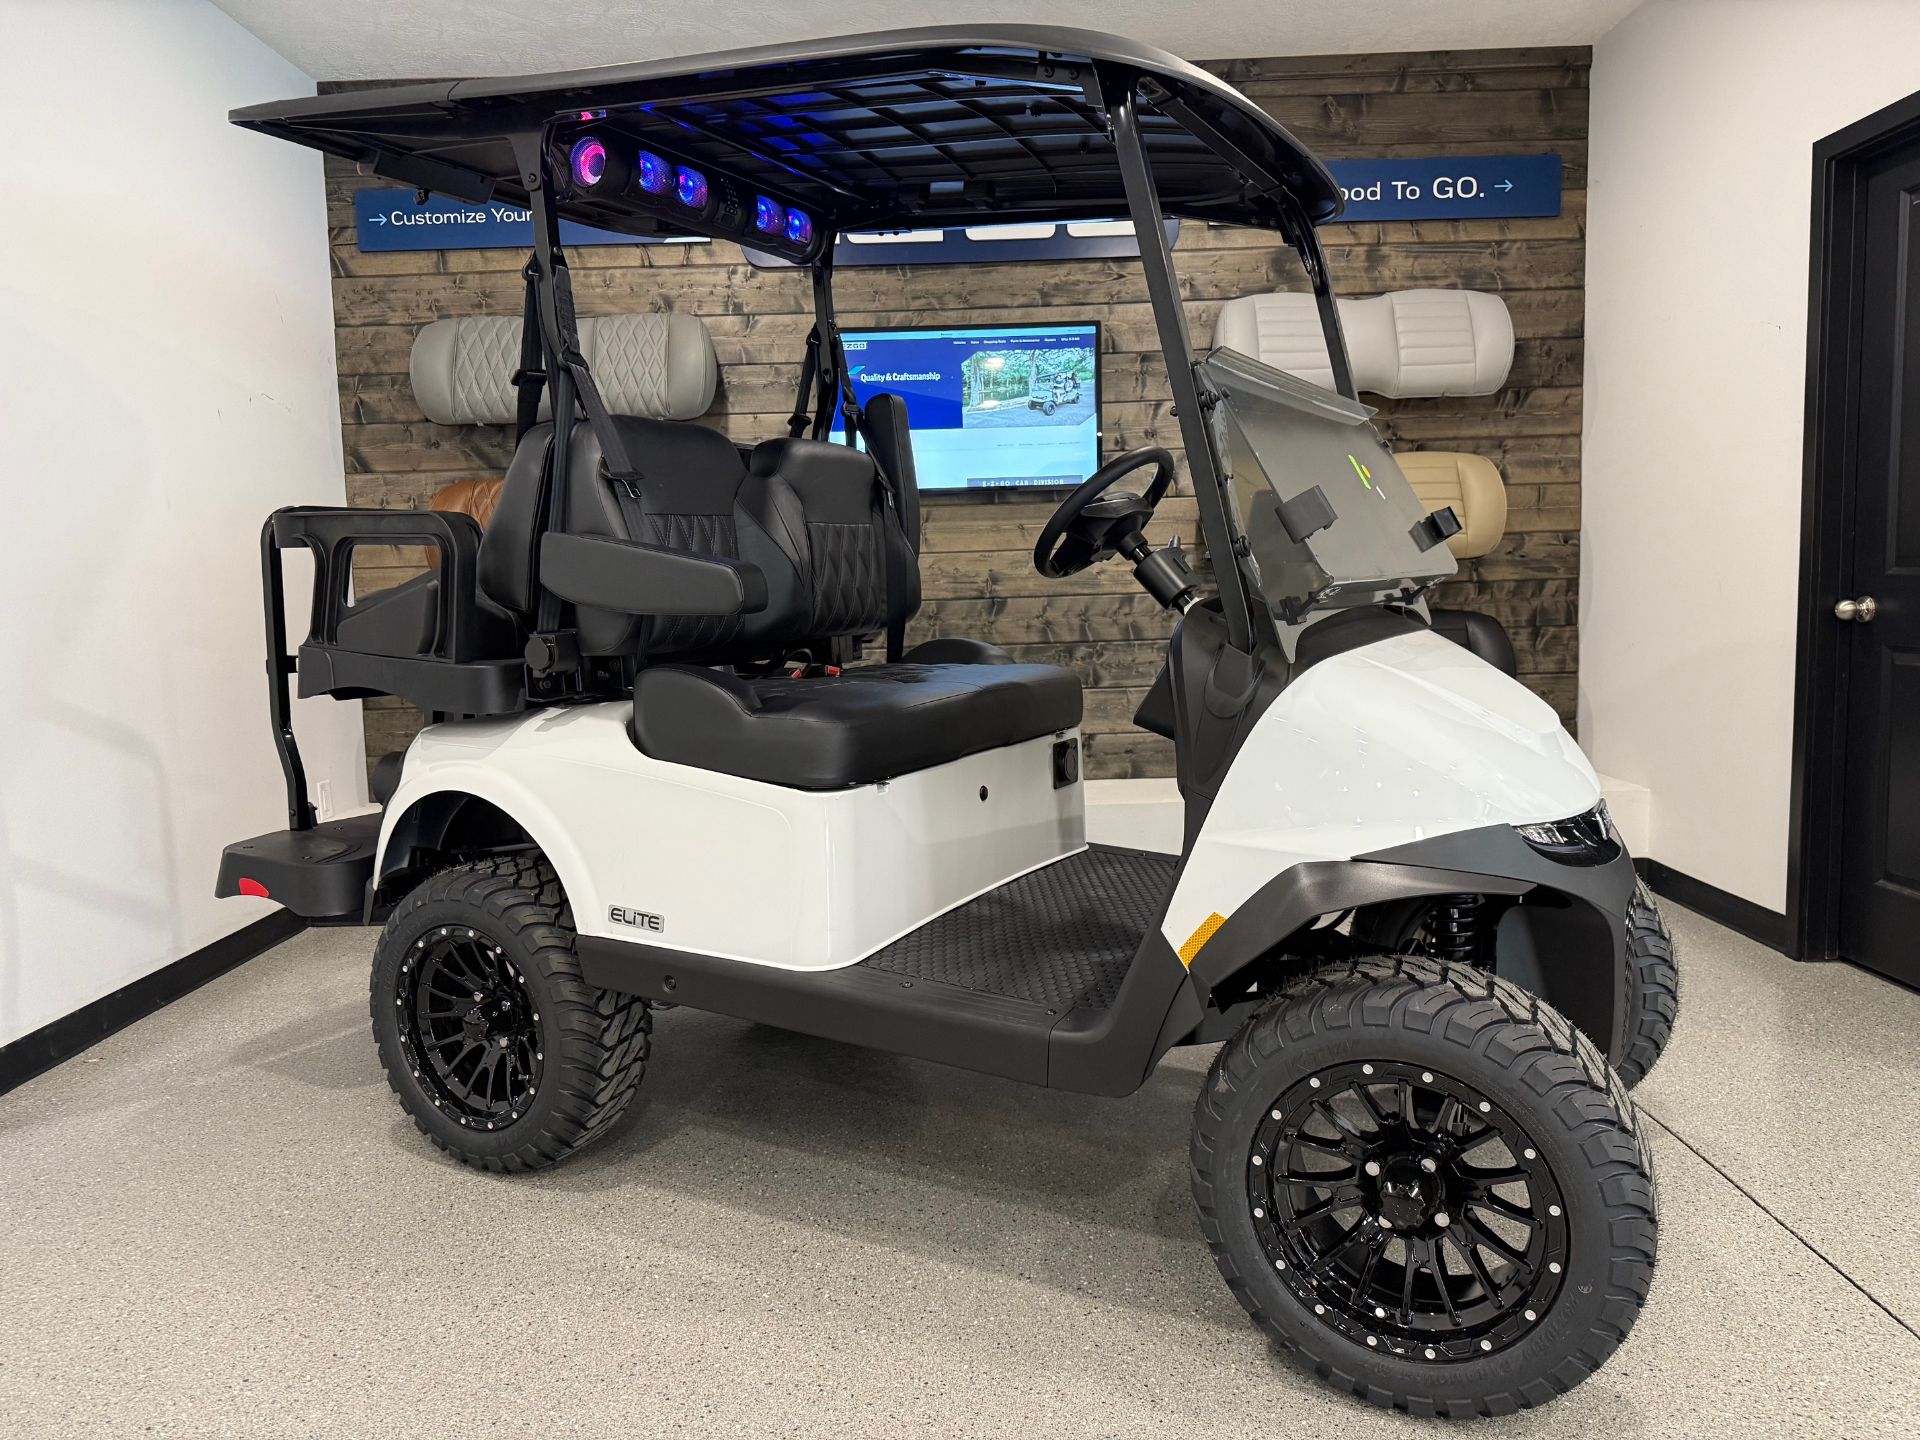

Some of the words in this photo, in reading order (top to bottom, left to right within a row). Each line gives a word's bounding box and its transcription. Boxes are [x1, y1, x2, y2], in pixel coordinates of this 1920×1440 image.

[1391, 181, 1421, 200] To
[1432, 176, 1485, 199] GO.
[391, 209, 487, 226] Customize
[491, 207, 533, 223] Your
[860, 373, 886, 383] Quality
[892, 372, 941, 382] Craftsmanship
